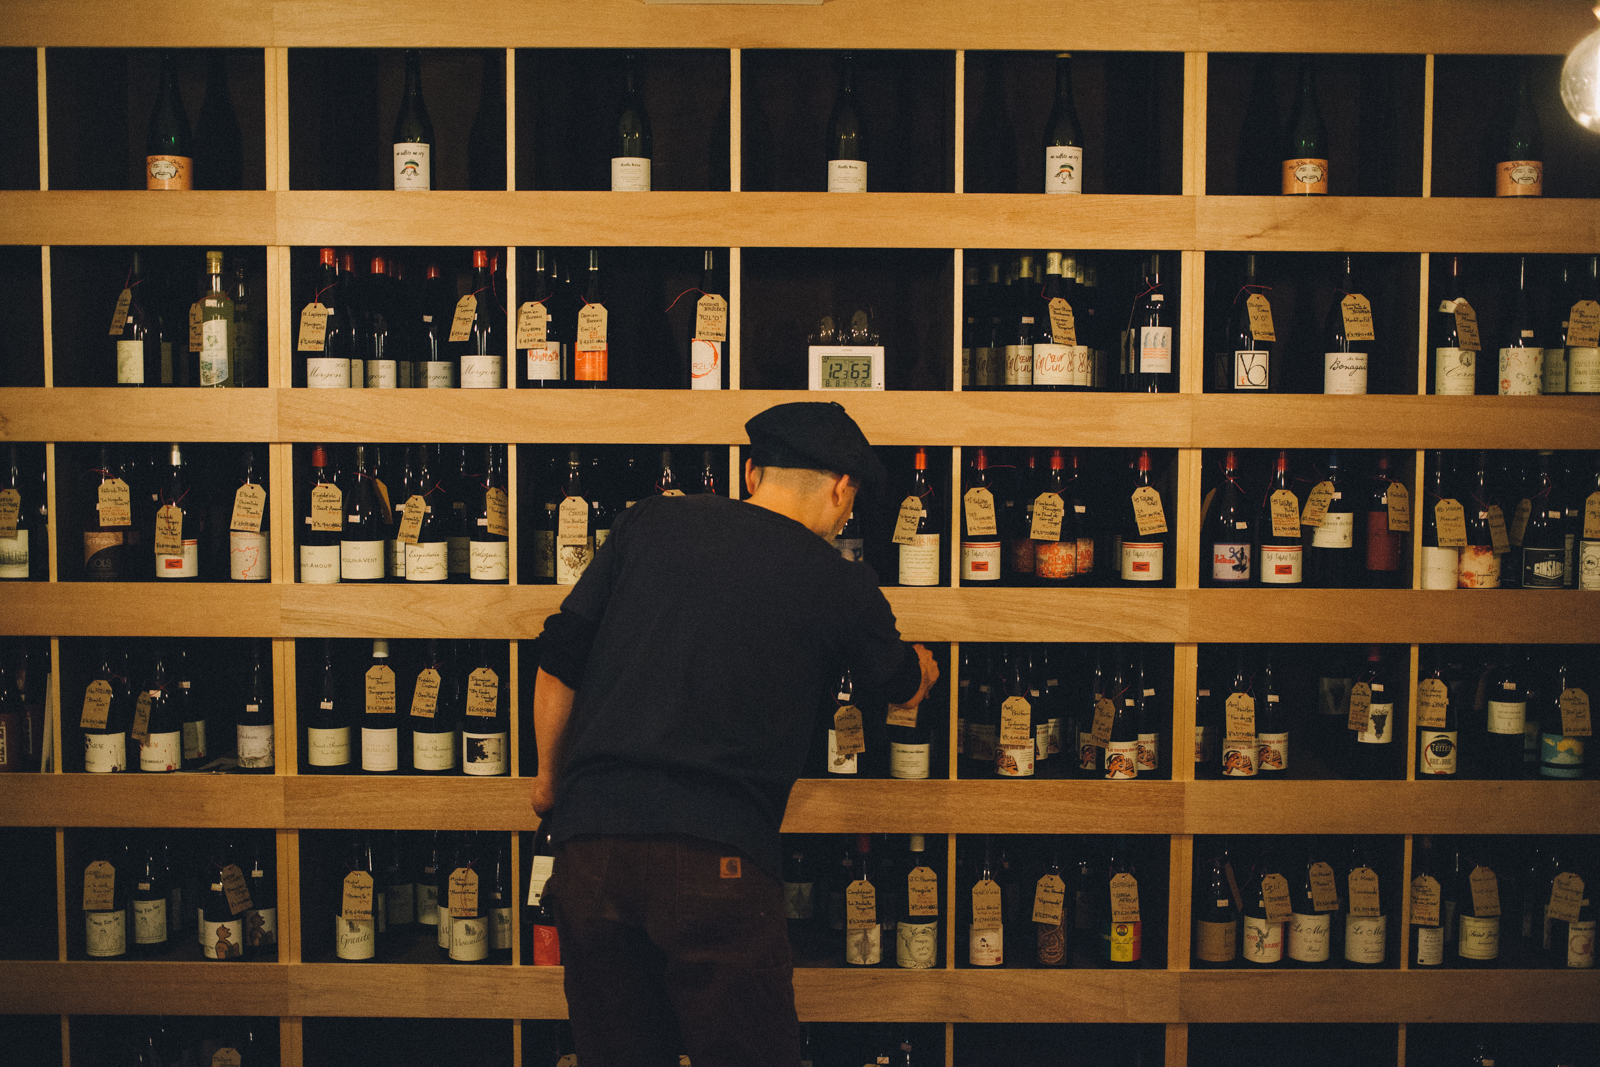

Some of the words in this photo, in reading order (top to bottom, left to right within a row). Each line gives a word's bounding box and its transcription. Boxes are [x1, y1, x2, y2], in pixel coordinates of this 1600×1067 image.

[692, 362, 719, 370] R2L'O
[309, 366, 342, 380] Morgon
[461, 363, 497, 380] Morgon
[1431, 744, 1452, 753] Terres
[1111, 881, 1136, 889] SORGA
[1292, 923, 1303, 933] Le
[1352, 925, 1363, 935] Le
[340, 932, 371, 950] Granite
